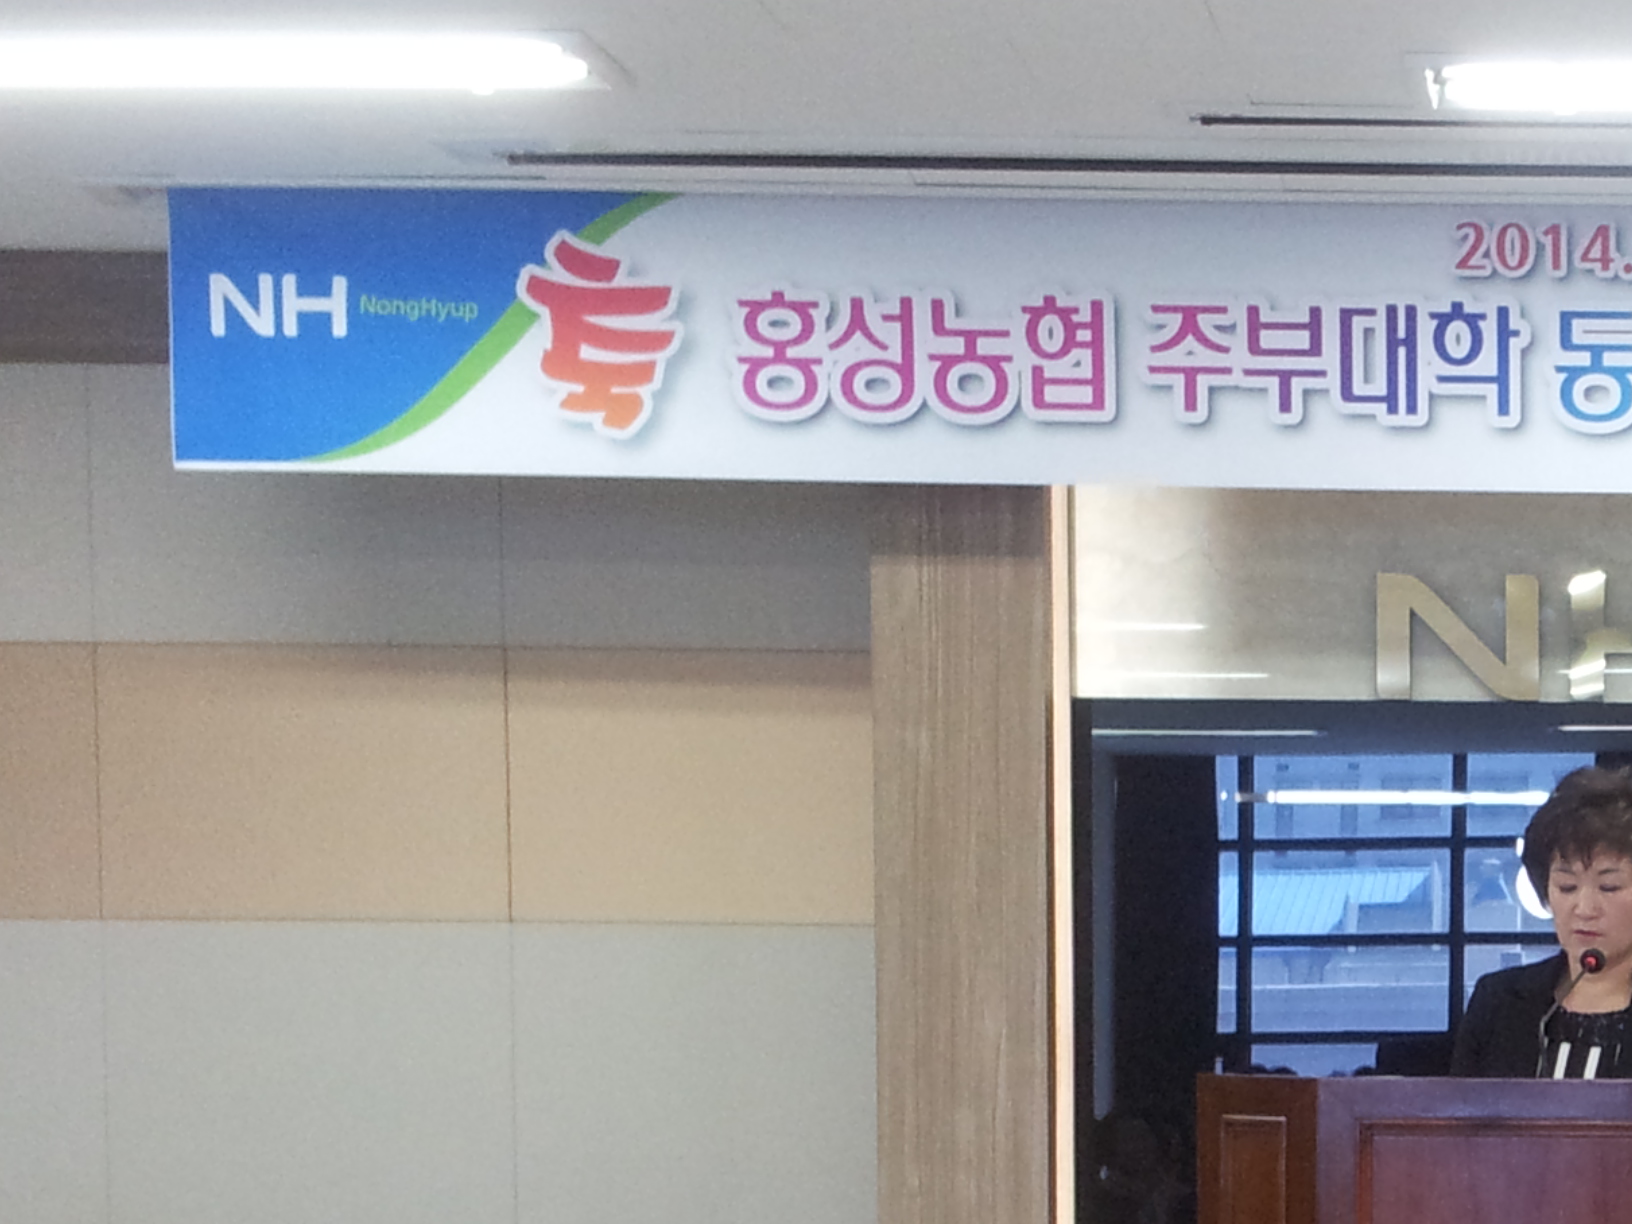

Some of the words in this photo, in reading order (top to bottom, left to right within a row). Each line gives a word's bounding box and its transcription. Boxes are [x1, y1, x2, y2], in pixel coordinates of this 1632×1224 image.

[208, 272, 348, 338] NH
[359, 293, 479, 323] NongHyup
[735, 289, 1107, 415] 홍성농협
[1145, 301, 1522, 418] 주부대학
